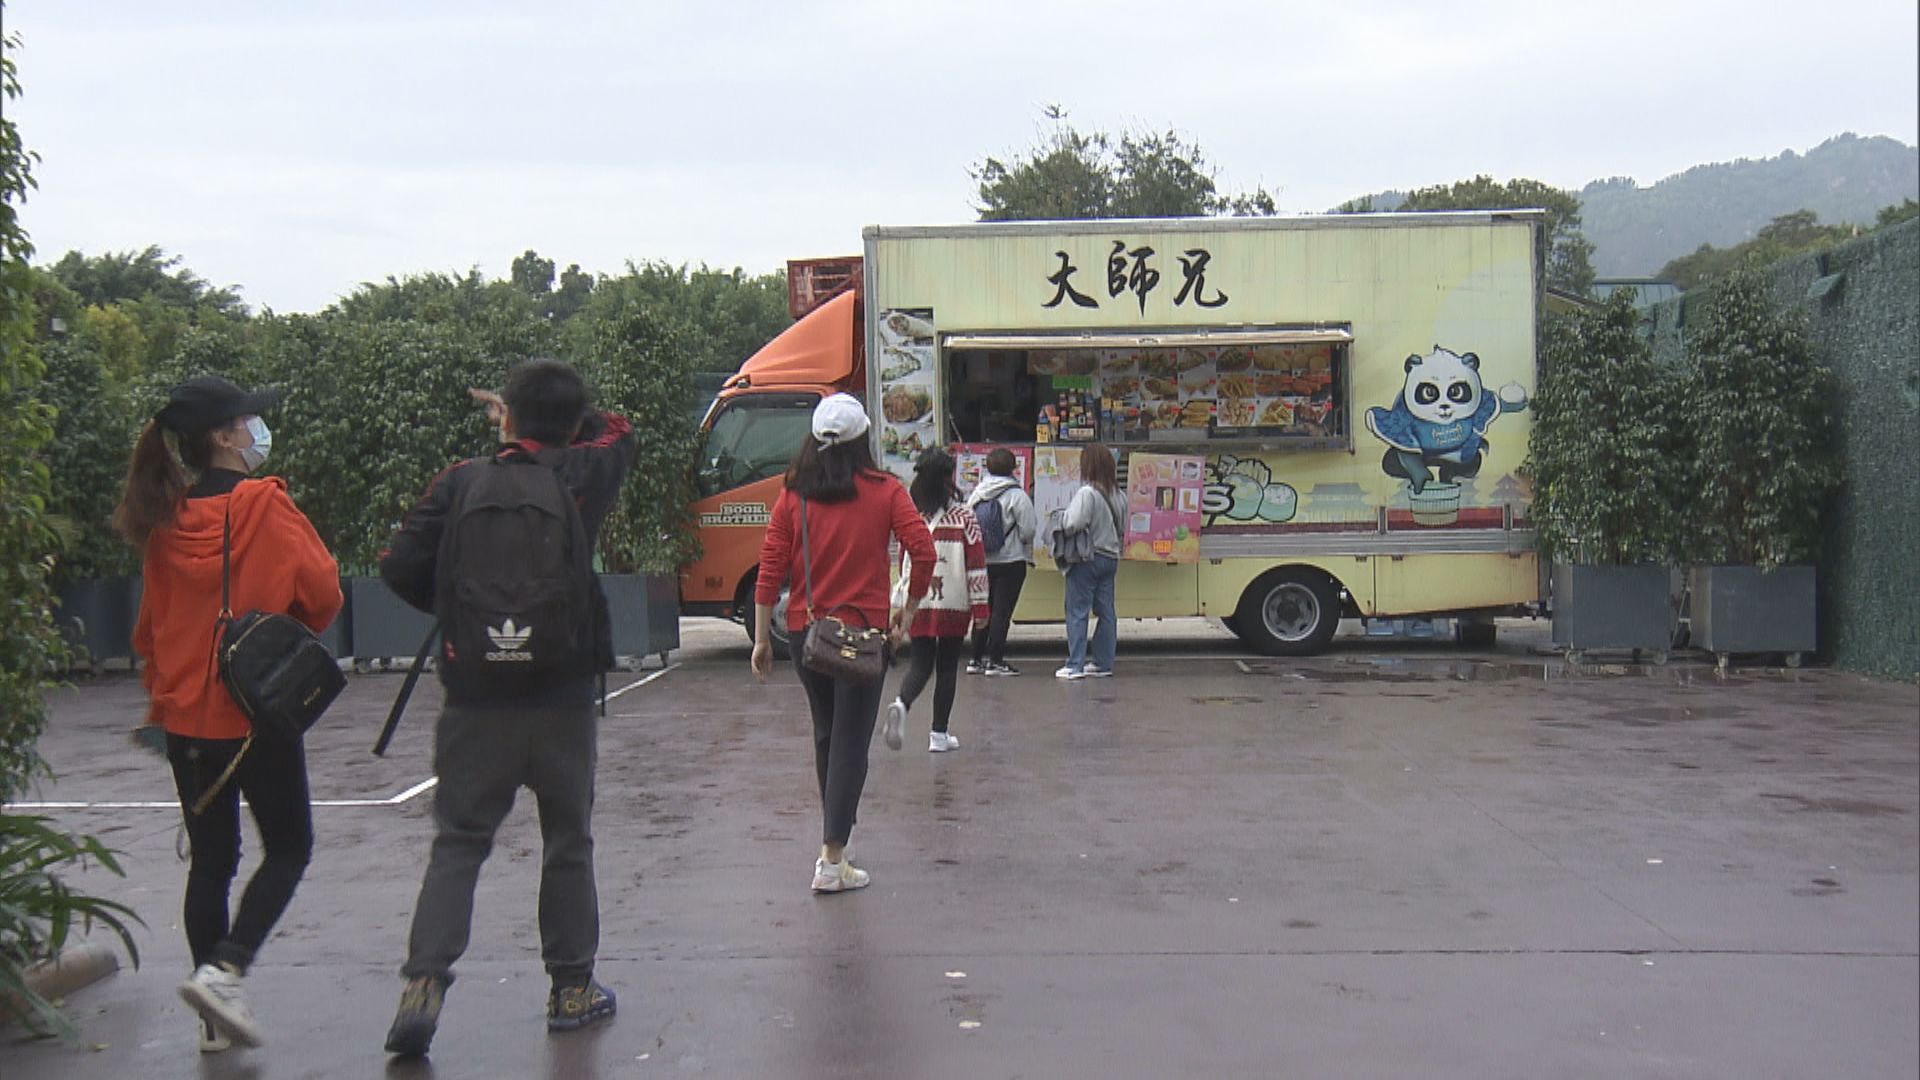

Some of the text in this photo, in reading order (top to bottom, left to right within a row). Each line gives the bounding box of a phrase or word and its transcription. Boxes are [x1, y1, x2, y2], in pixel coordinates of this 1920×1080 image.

[1041, 240, 1229, 318] 大師兄
[722, 505, 763, 514] BOOK
[701, 514, 769, 524] BROTHER
[485, 650, 532, 661] adidas
